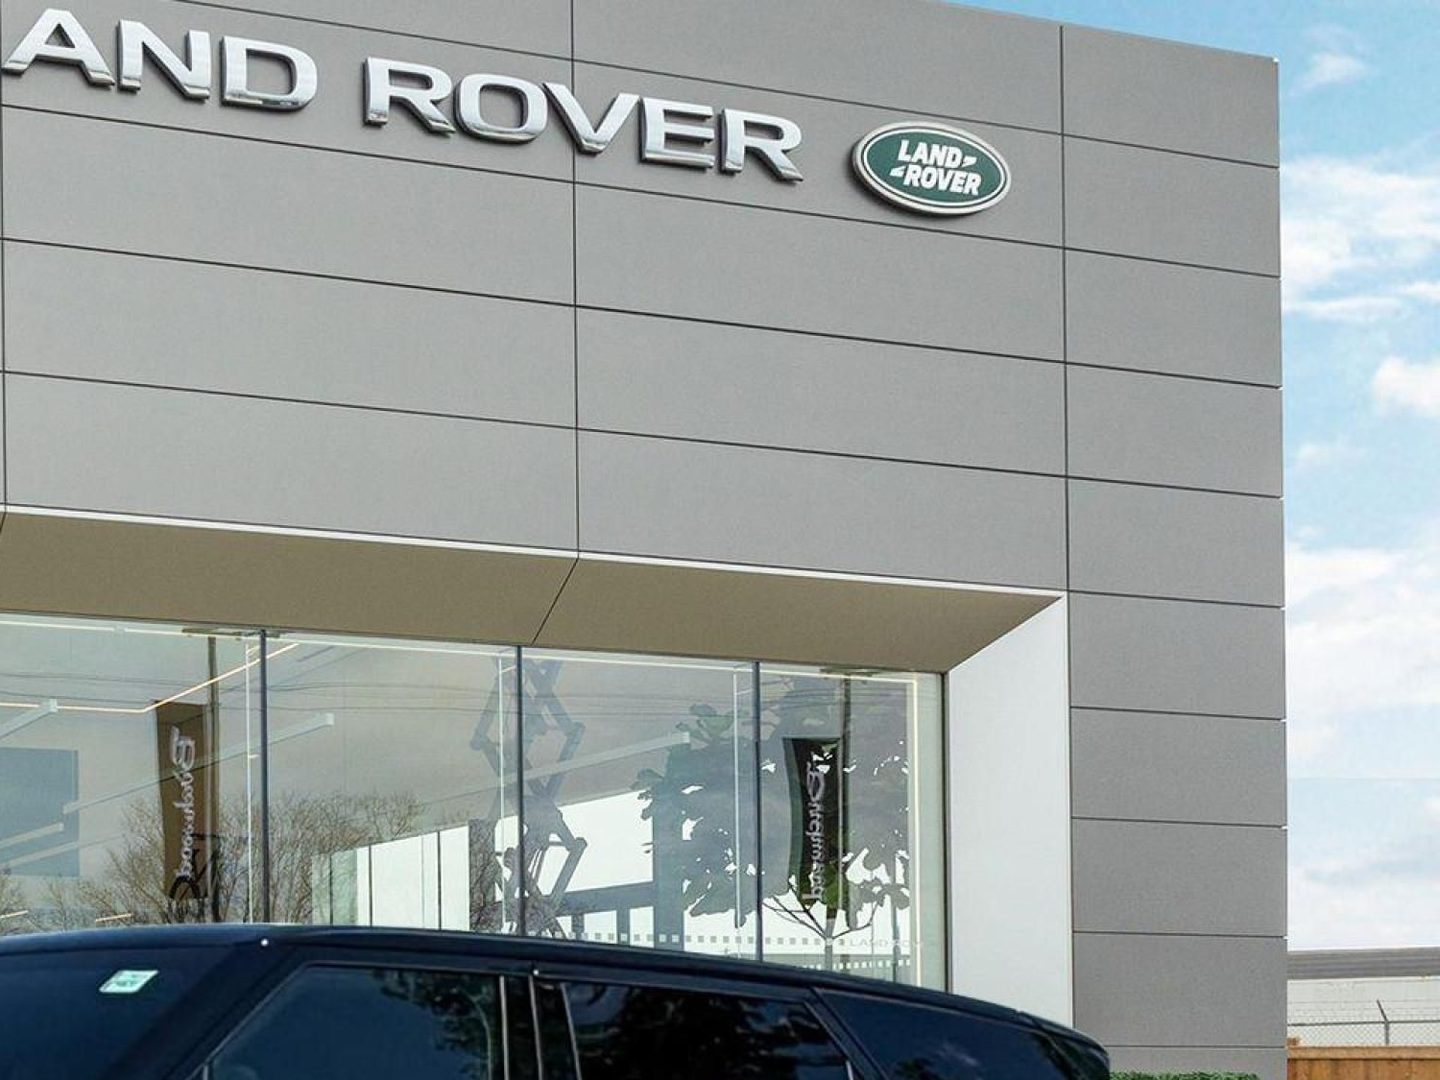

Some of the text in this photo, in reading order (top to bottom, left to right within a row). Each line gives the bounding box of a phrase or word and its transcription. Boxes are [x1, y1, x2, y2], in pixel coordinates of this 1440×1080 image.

[363, 56, 804, 182] ROVER
[897, 139, 963, 169] LAND
[902, 163, 982, 196] ROVER
